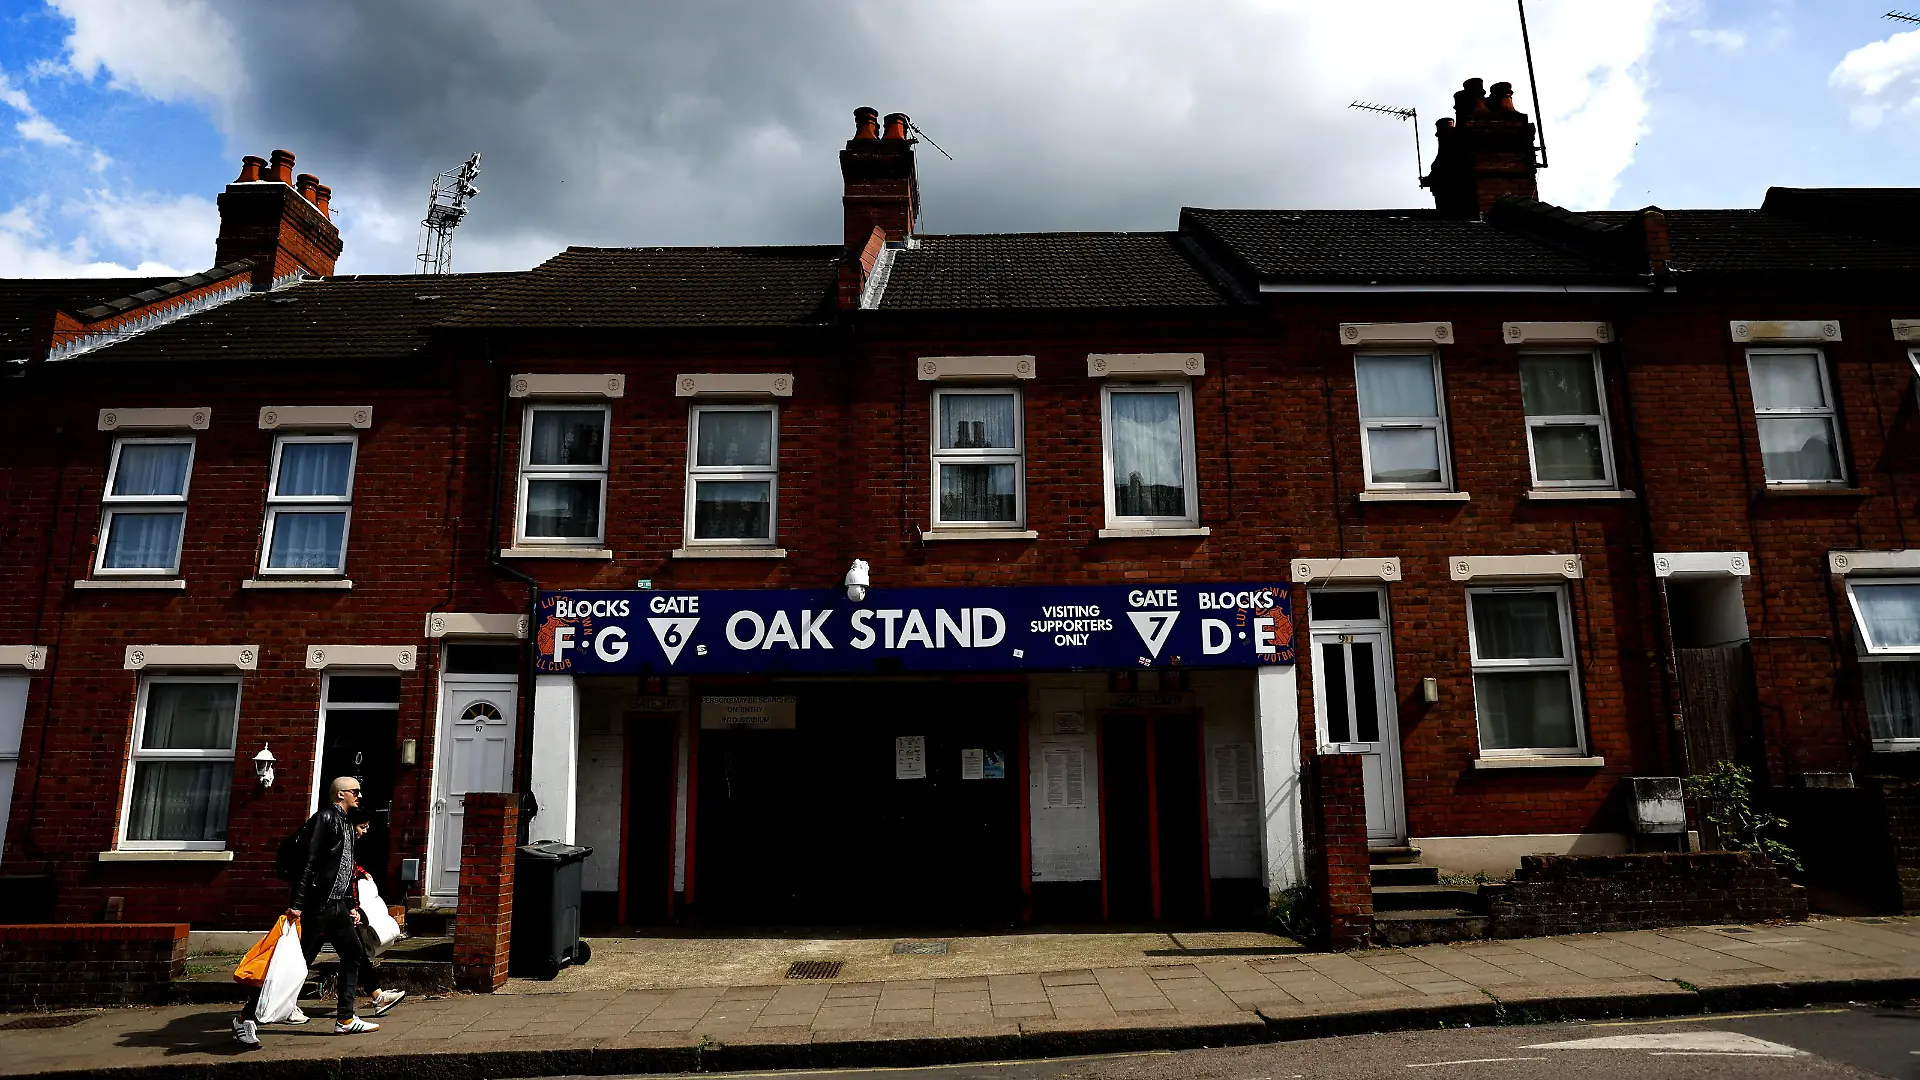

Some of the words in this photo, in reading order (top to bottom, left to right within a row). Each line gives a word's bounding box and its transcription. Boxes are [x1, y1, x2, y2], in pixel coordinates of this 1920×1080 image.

[649, 596, 699, 613] GATE
[1128, 589, 1178, 608] GATE
[1198, 591, 1274, 610] BLOCKS
[555, 600, 630, 618] BLOCKS
[1042, 605, 1100, 618] VISITING
[725, 609, 834, 650] OAK
[849, 607, 1006, 649] STAND
[1030, 618, 1113, 633] SUPPORTERS
[1149, 617, 1168, 642] 7
[663, 623, 682, 648] 6
[1054, 634, 1090, 647] ONLY
[475, 725, 483, 733] 87
